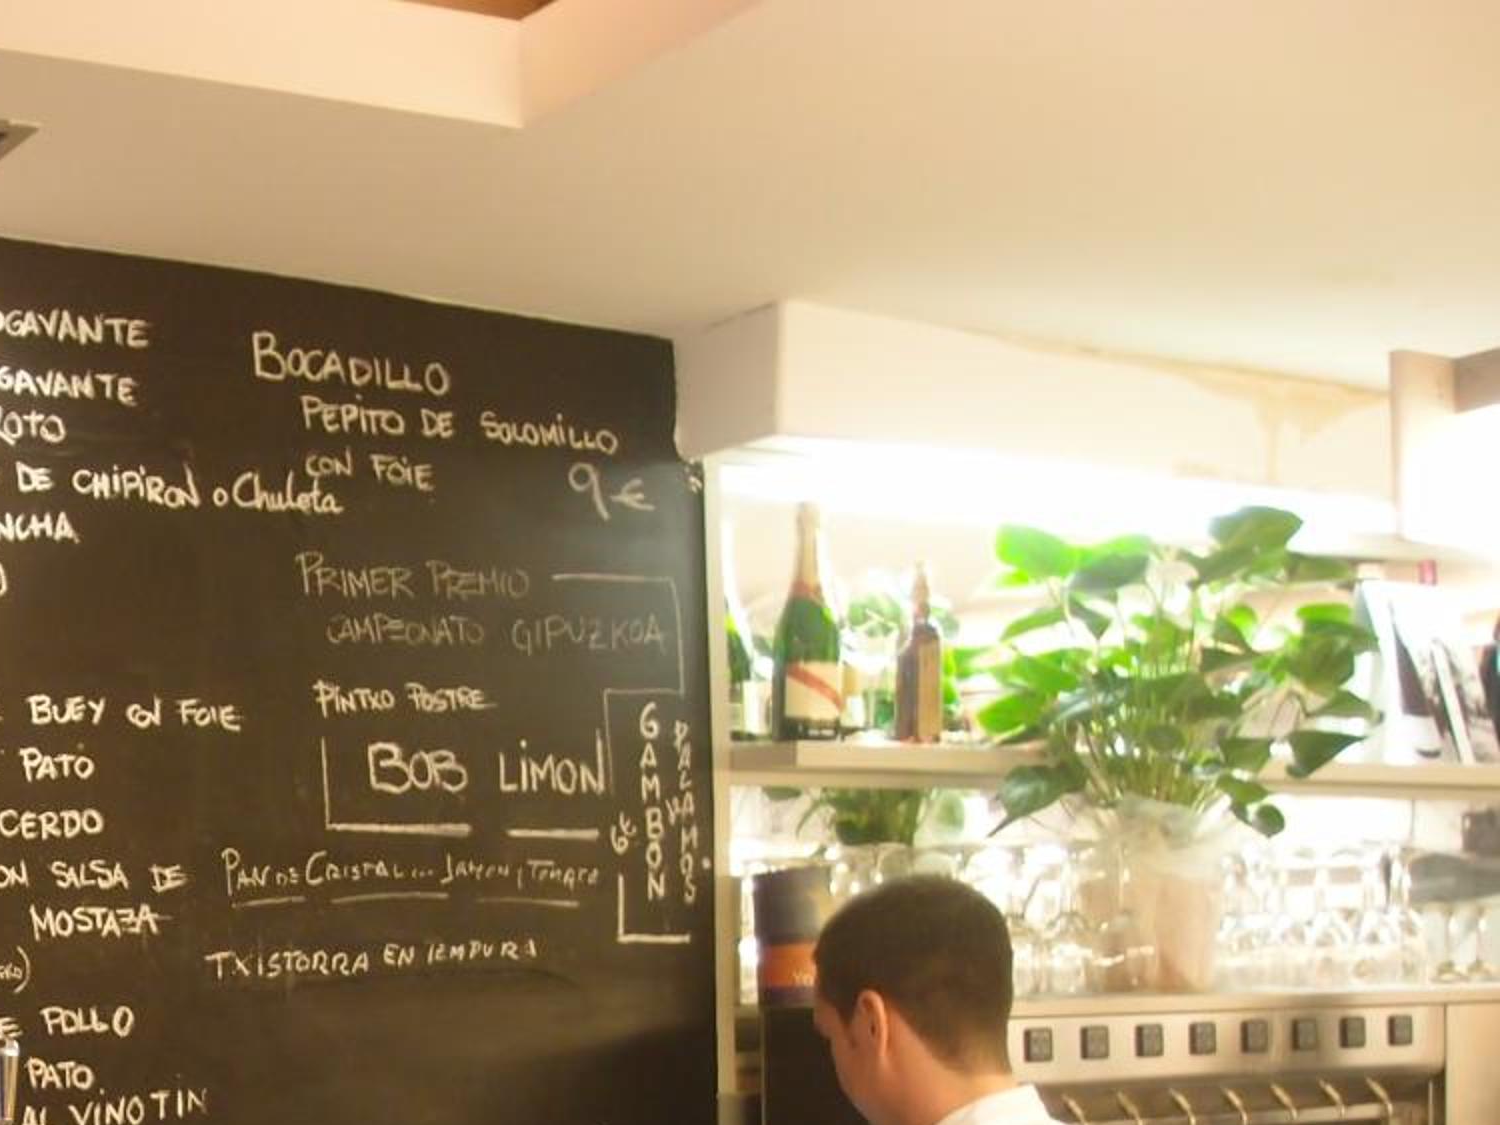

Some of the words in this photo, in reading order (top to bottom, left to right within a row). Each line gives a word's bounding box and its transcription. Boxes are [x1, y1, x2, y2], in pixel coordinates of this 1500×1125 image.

[252, 331, 450, 396] BOCADILLO
[300, 394, 405, 436] PEPITO
[420, 408, 455, 439] DE
[480, 411, 618, 453] SOLOMILLO
[16, 461, 52, 492] DE
[72, 462, 200, 508] CHIPIRON
[306, 452, 353, 478] CON
[371, 454, 436, 490] FOIE
[296, 550, 413, 598] PRIMER
[425, 559, 531, 600] PREMIO
[326, 614, 484, 644] CAMPEONATO
[511, 616, 667, 655] GIPUZKOA
[27, 694, 106, 725] BUEY
[177, 699, 245, 732] FOIE
[312, 678, 396, 716] PINTXO
[406, 681, 498, 713] POSTRE
[20, 747, 96, 783] PATO
[367, 742, 468, 792] BOB
[499, 730, 605, 794] LIMON
[51, 859, 130, 889] SALSA
[150, 863, 189, 893] DE
[221, 848, 269, 896] PAN
[205, 950, 370, 981] TXISTORRA
[383, 943, 415, 967] EN
[40, 1005, 136, 1040] POLLO
[25, 1056, 96, 1093] PATO
